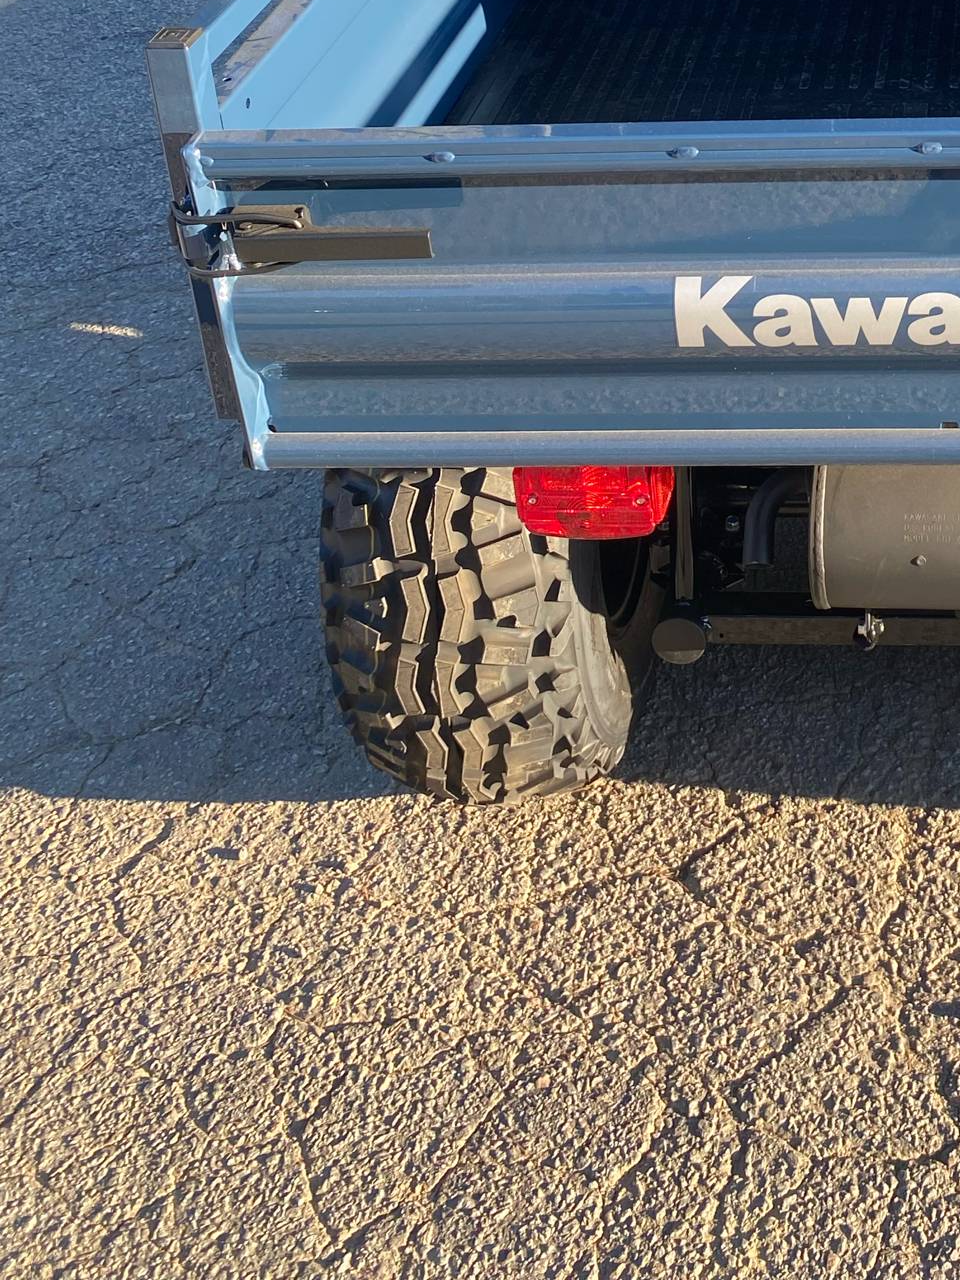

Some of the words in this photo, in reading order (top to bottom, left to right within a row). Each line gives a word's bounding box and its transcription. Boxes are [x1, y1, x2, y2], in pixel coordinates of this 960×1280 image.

[903, 513, 946, 522] KAWASAKI
[922, 524, 955, 532] FOREST
[903, 534, 929, 542] MODEL
